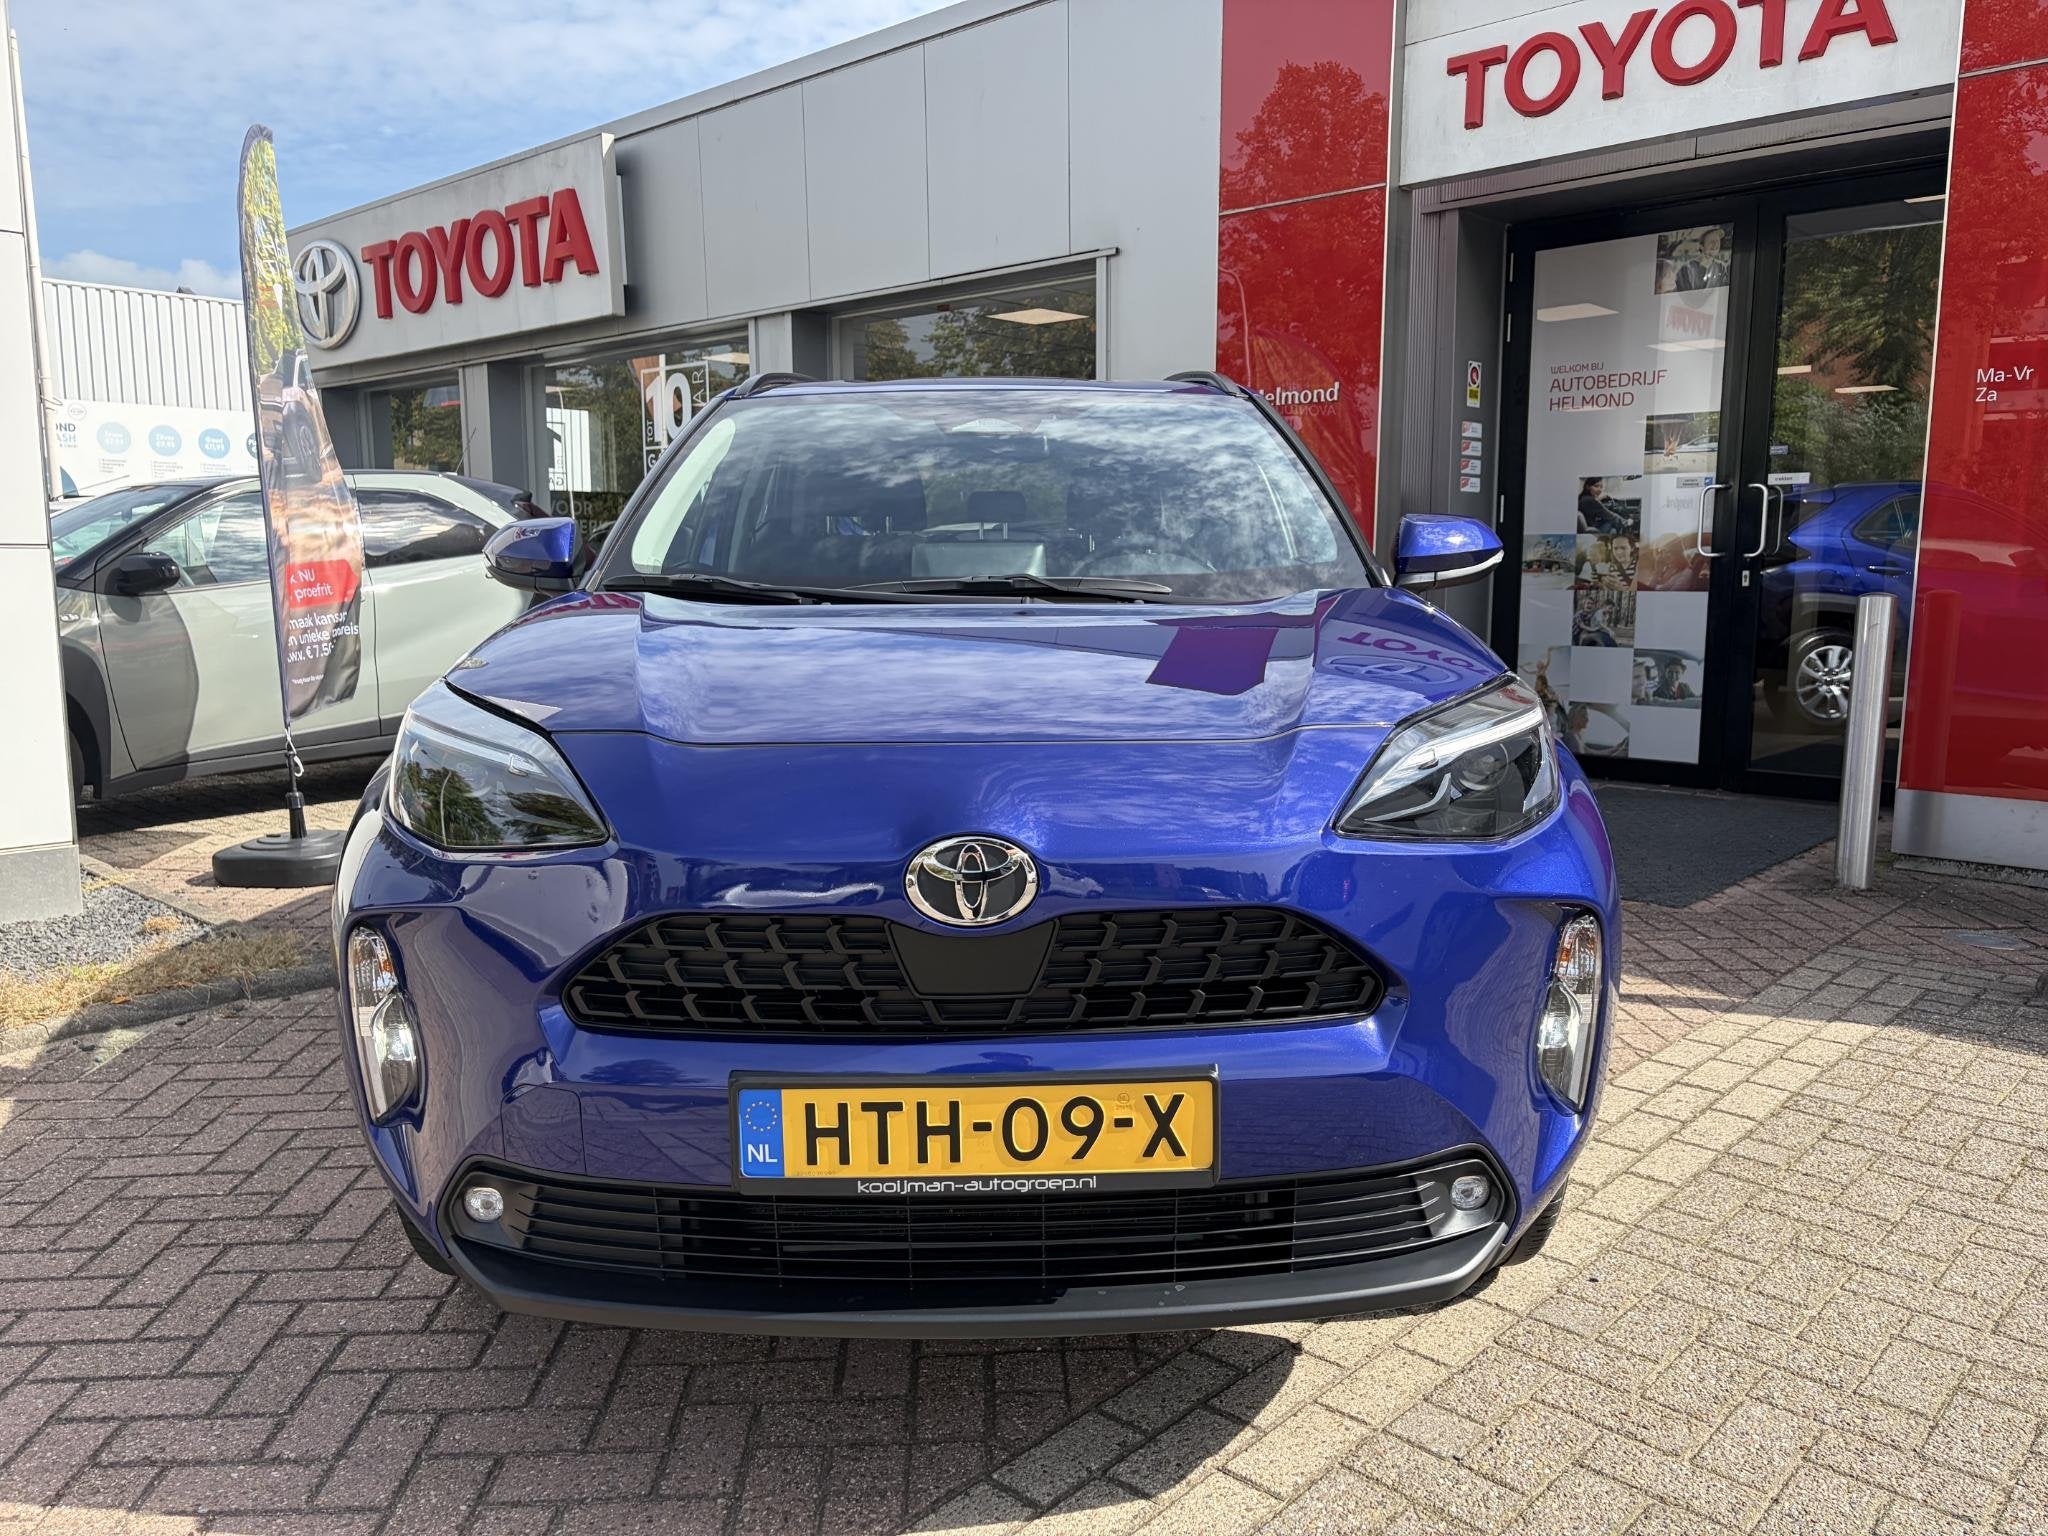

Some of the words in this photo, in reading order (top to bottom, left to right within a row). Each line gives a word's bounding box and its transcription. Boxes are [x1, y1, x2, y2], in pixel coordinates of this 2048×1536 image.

[1447, 0, 1898, 130] TOYOTA
[361, 188, 599, 319] TOYOTA
[1550, 363, 1590, 375] WELKOM
[1976, 365, 2035, 383] Ma-Vr
[692, 369, 707, 407] AR
[1549, 370, 1668, 393] AUTOBEDRIJF
[1259, 381, 1340, 406] elmond
[1549, 391, 1635, 411] HELMOND
[1975, 387, 1998, 402] Za
[644, 372, 693, 443] 10
[55, 422, 76, 433] ND
[297, 568, 316, 583] NU
[294, 582, 334, 603] proefrit
[288, 613, 314, 631] maak
[299, 629, 331, 645] unieke
[803, 1093, 1188, 1167] HTH-09-X
[746, 1144, 778, 1164] NL
[857, 1176, 1097, 1194] kooijman-autogroep.nl
